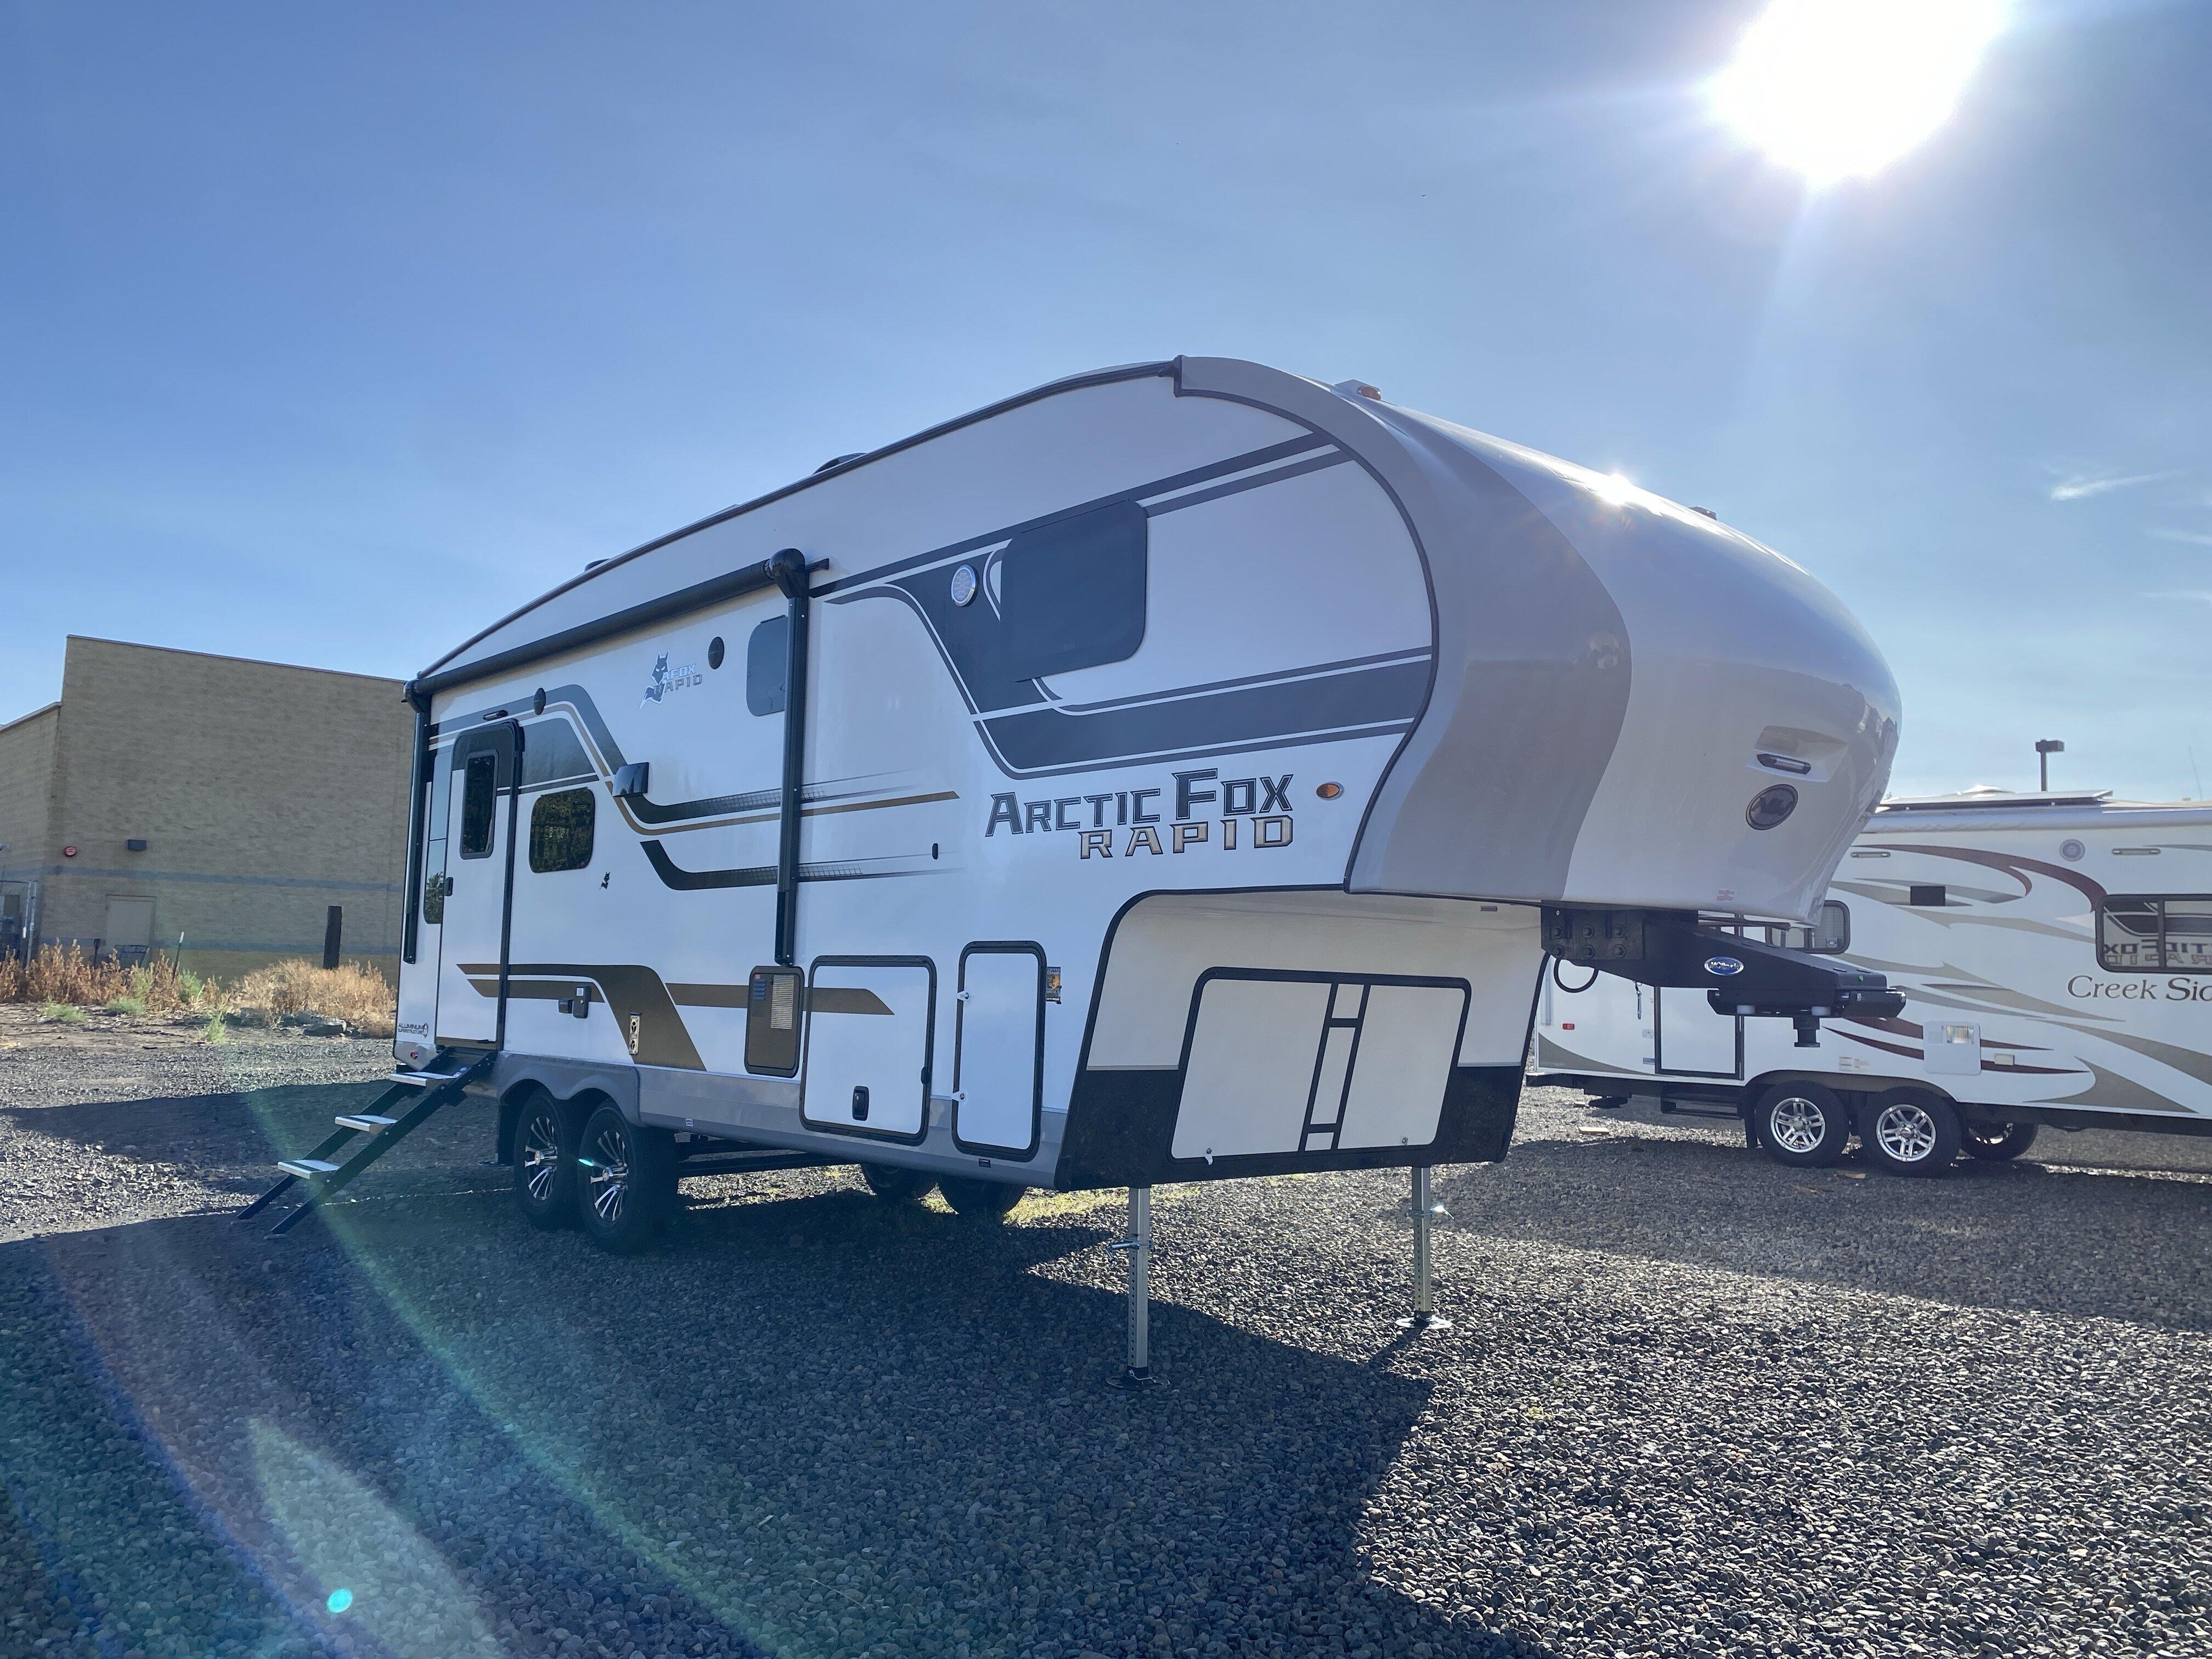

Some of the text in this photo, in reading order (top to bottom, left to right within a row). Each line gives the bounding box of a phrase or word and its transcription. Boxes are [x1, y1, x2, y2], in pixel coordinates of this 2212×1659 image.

[662, 664, 696, 680] AFOX
[653, 674, 703, 695] RAPID
[1077, 815, 1294, 859] RAPID
[2067, 975, 2157, 1000] Creek
